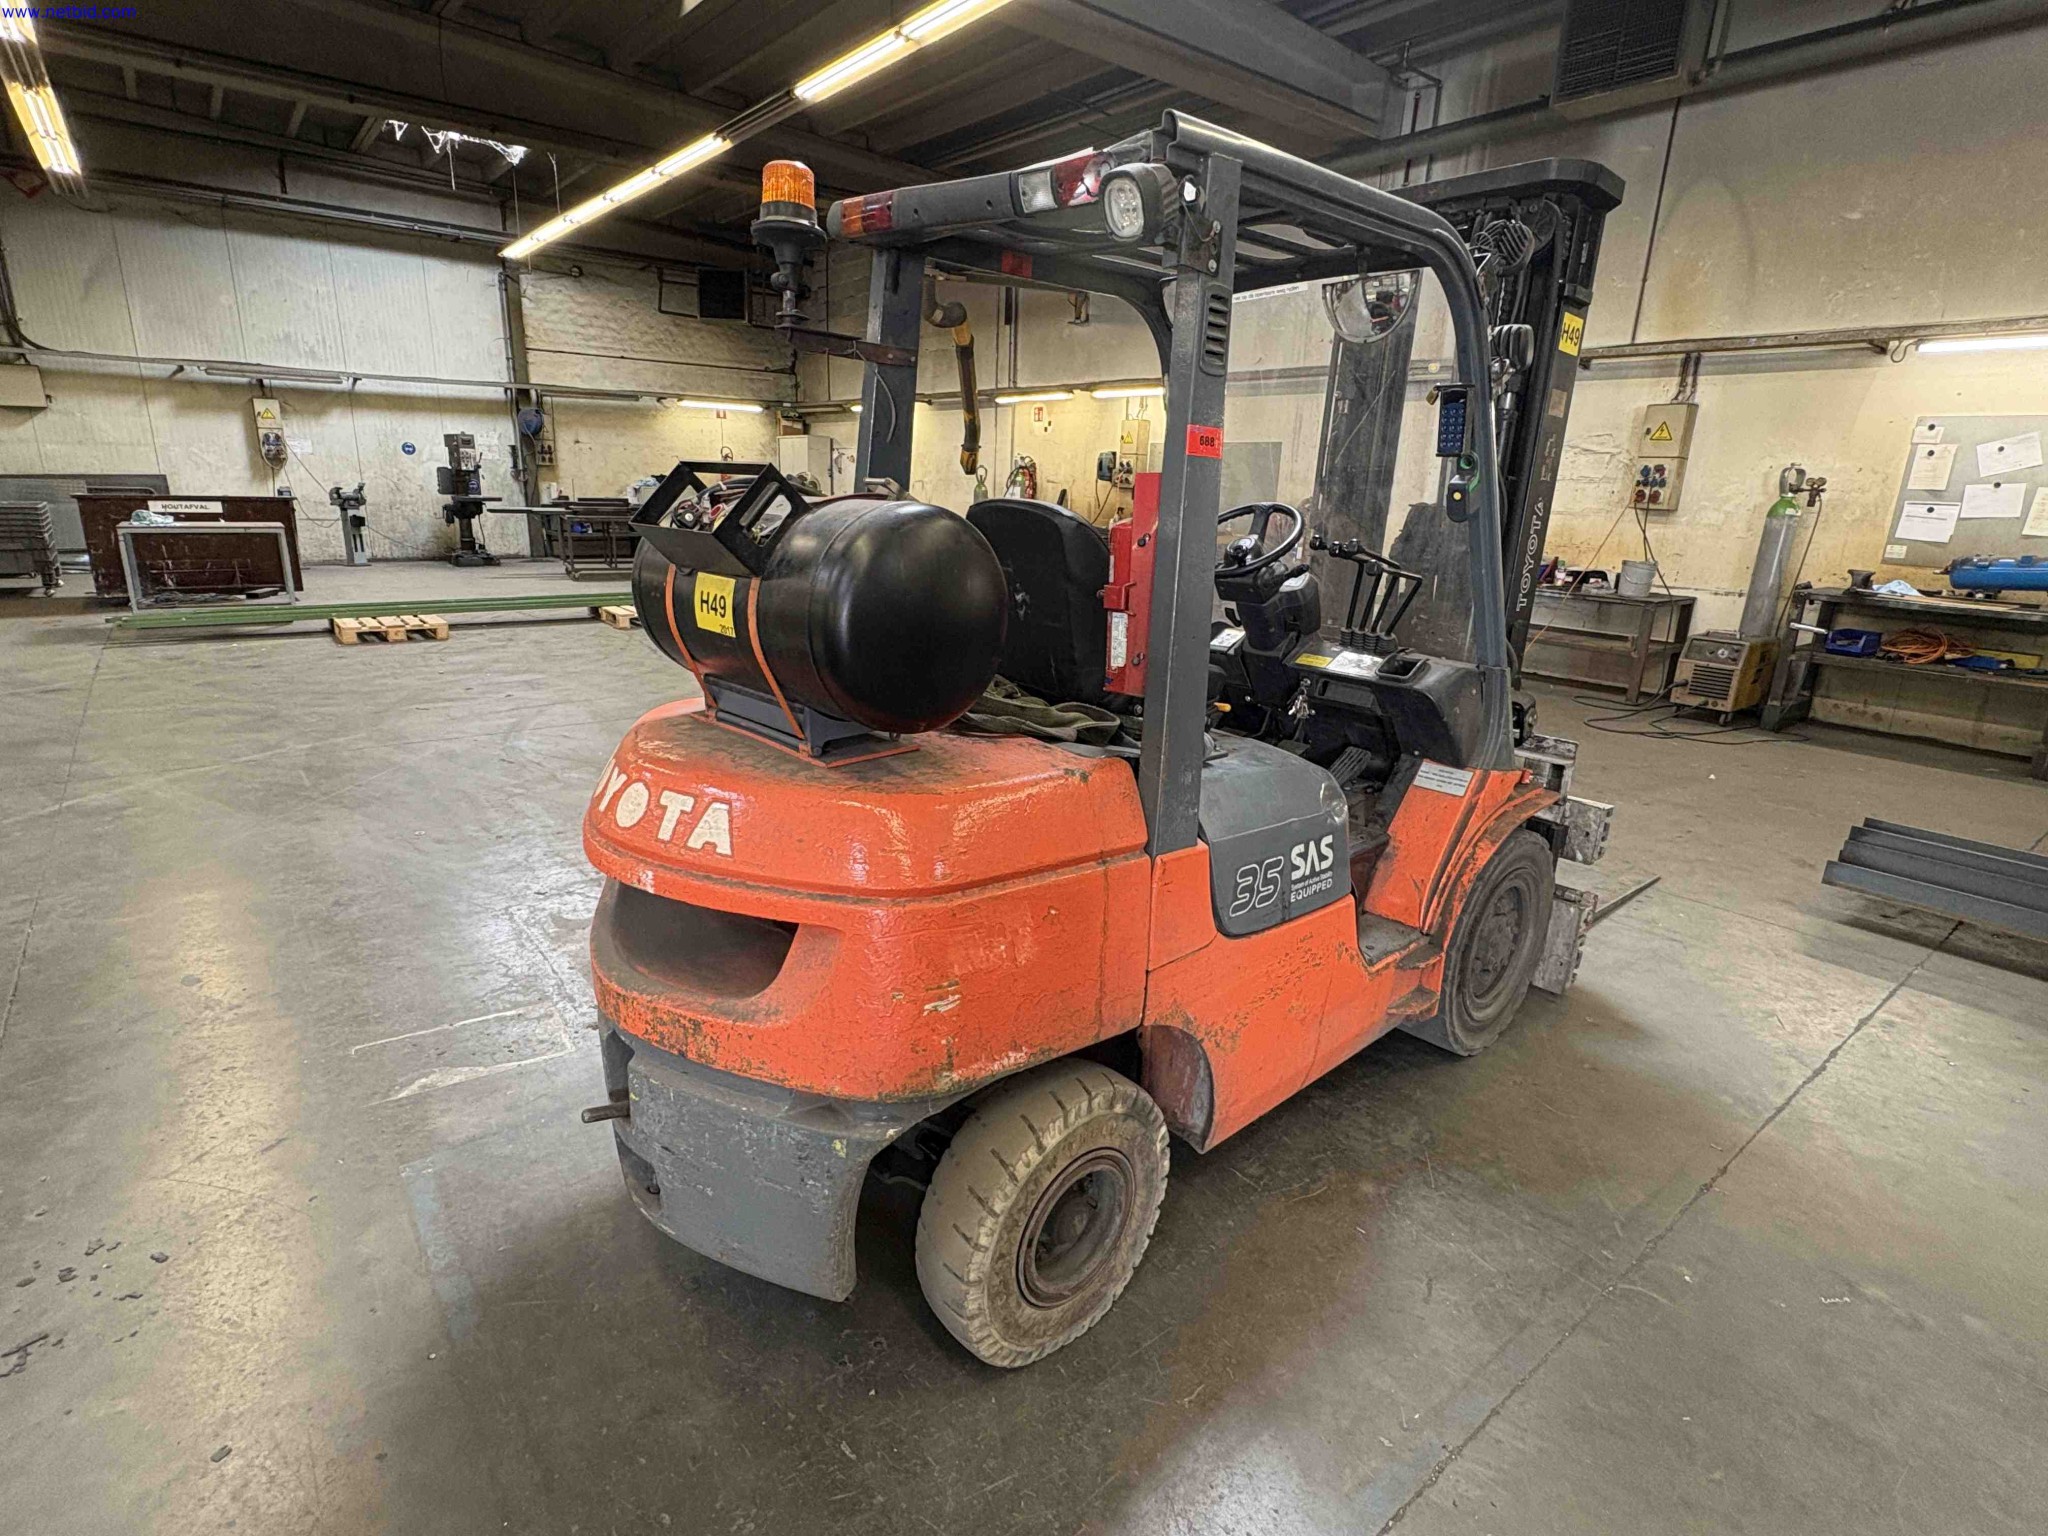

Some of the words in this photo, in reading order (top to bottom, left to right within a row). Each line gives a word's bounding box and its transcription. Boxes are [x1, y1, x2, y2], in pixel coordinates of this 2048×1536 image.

[1562, 322, 1580, 347] H49
[1199, 436, 1215, 447] 688
[1516, 497, 1545, 612] TOYOTA
[700, 590, 727, 618] H49
[1290, 834, 1334, 881] SAS
[1229, 855, 1284, 918] 35
[1290, 878, 1333, 903] EQUIPPED
